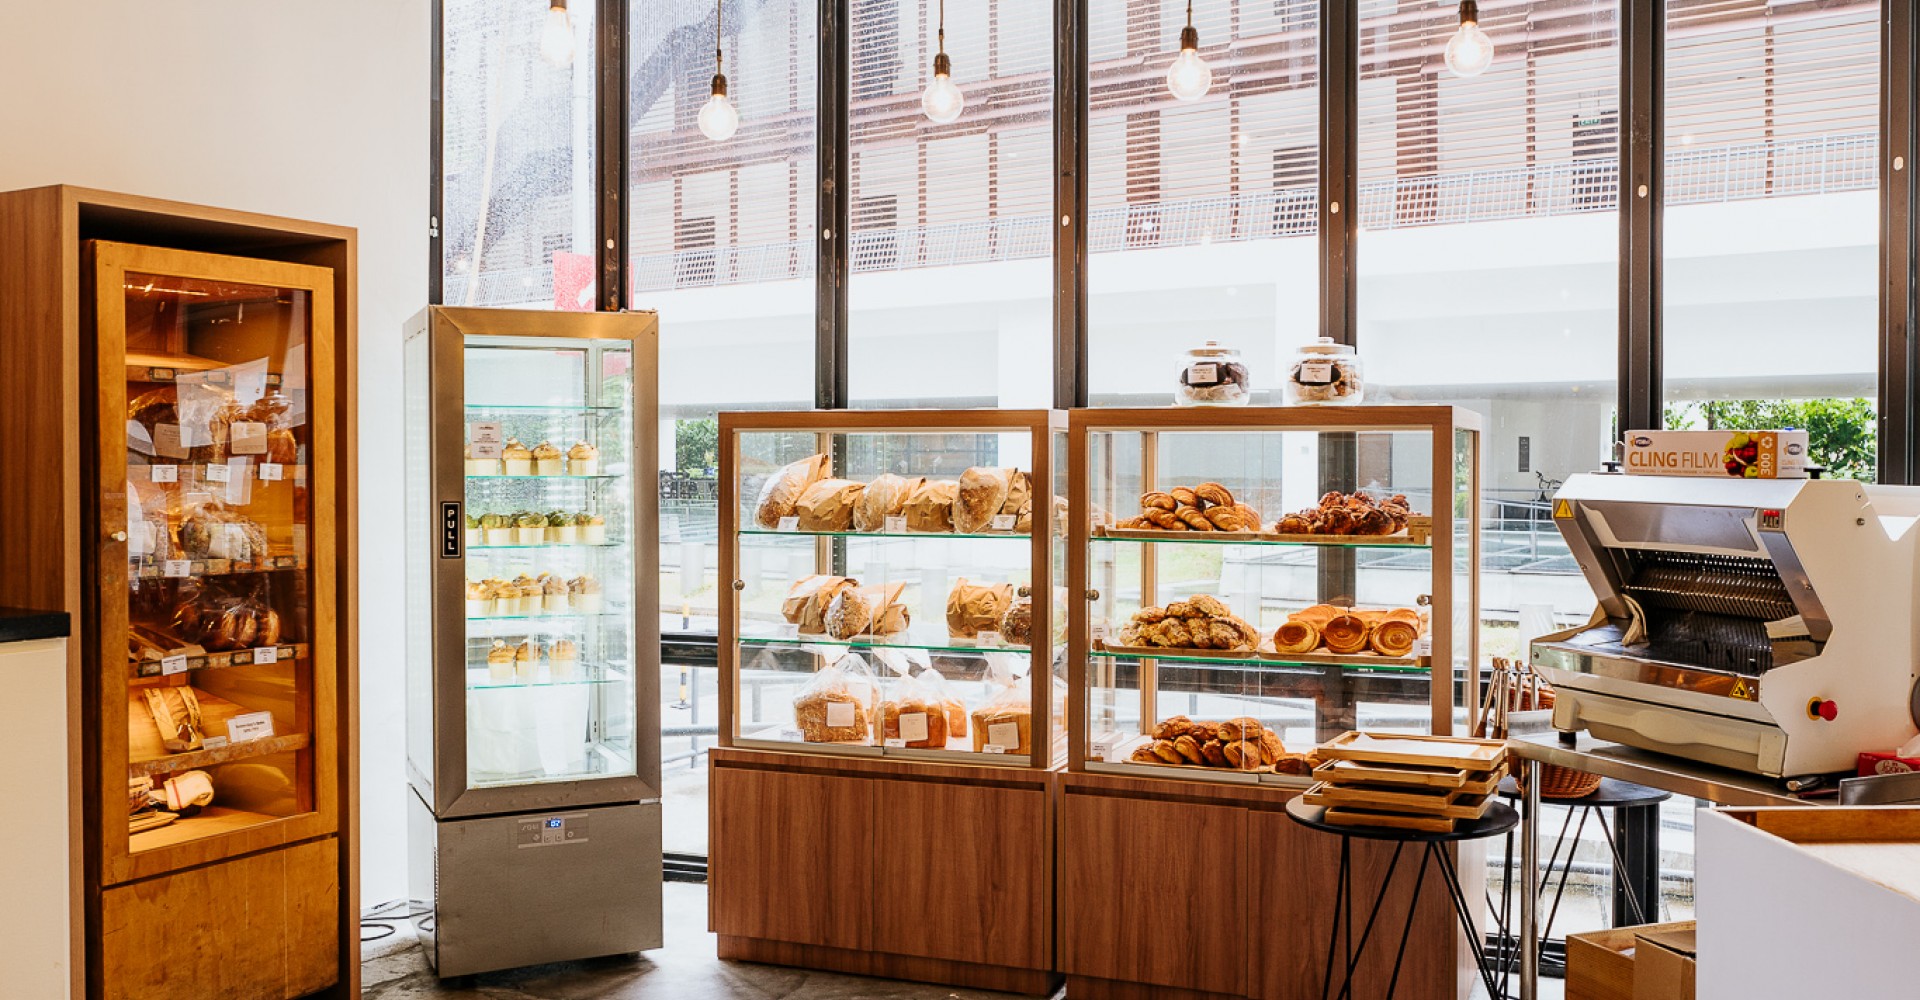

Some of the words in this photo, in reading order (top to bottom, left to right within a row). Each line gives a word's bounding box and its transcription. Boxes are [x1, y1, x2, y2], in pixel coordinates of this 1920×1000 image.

[1629, 451, 1677, 468] CLING
[1682, 452, 1719, 468] FILM
[1760, 453, 1771, 475] 300
[447, 509, 455, 550] PULL
